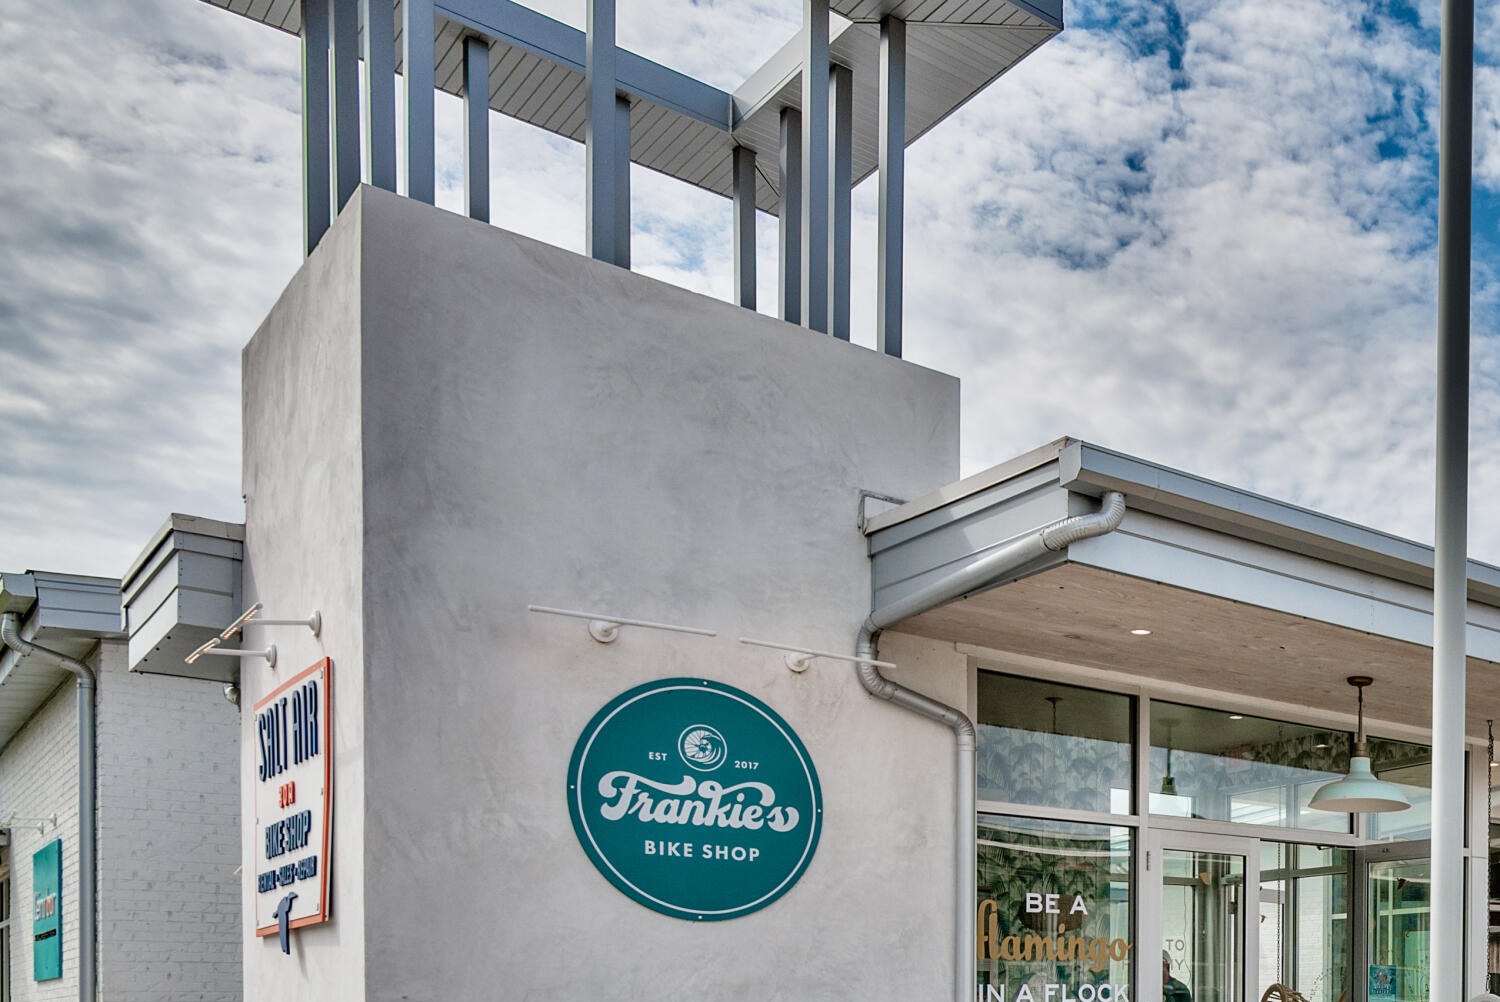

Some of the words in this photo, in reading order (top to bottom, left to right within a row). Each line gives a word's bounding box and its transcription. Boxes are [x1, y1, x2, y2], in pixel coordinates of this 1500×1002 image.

[258, 697, 288, 782] SALT
[292, 680, 319, 765] AIR
[648, 752, 667, 761] EST
[734, 760, 759, 770] 2017
[265, 819, 285, 860] BIKE
[285, 810, 312, 851] SHOP
[644, 840, 693, 857] BIKE
[702, 844, 760, 862] SHOP
[1026, 893, 1060, 914] BE
[1069, 895, 1088, 915] A
[977, 898, 1133, 973] flamingo
[1165, 939, 1185, 951] TO
